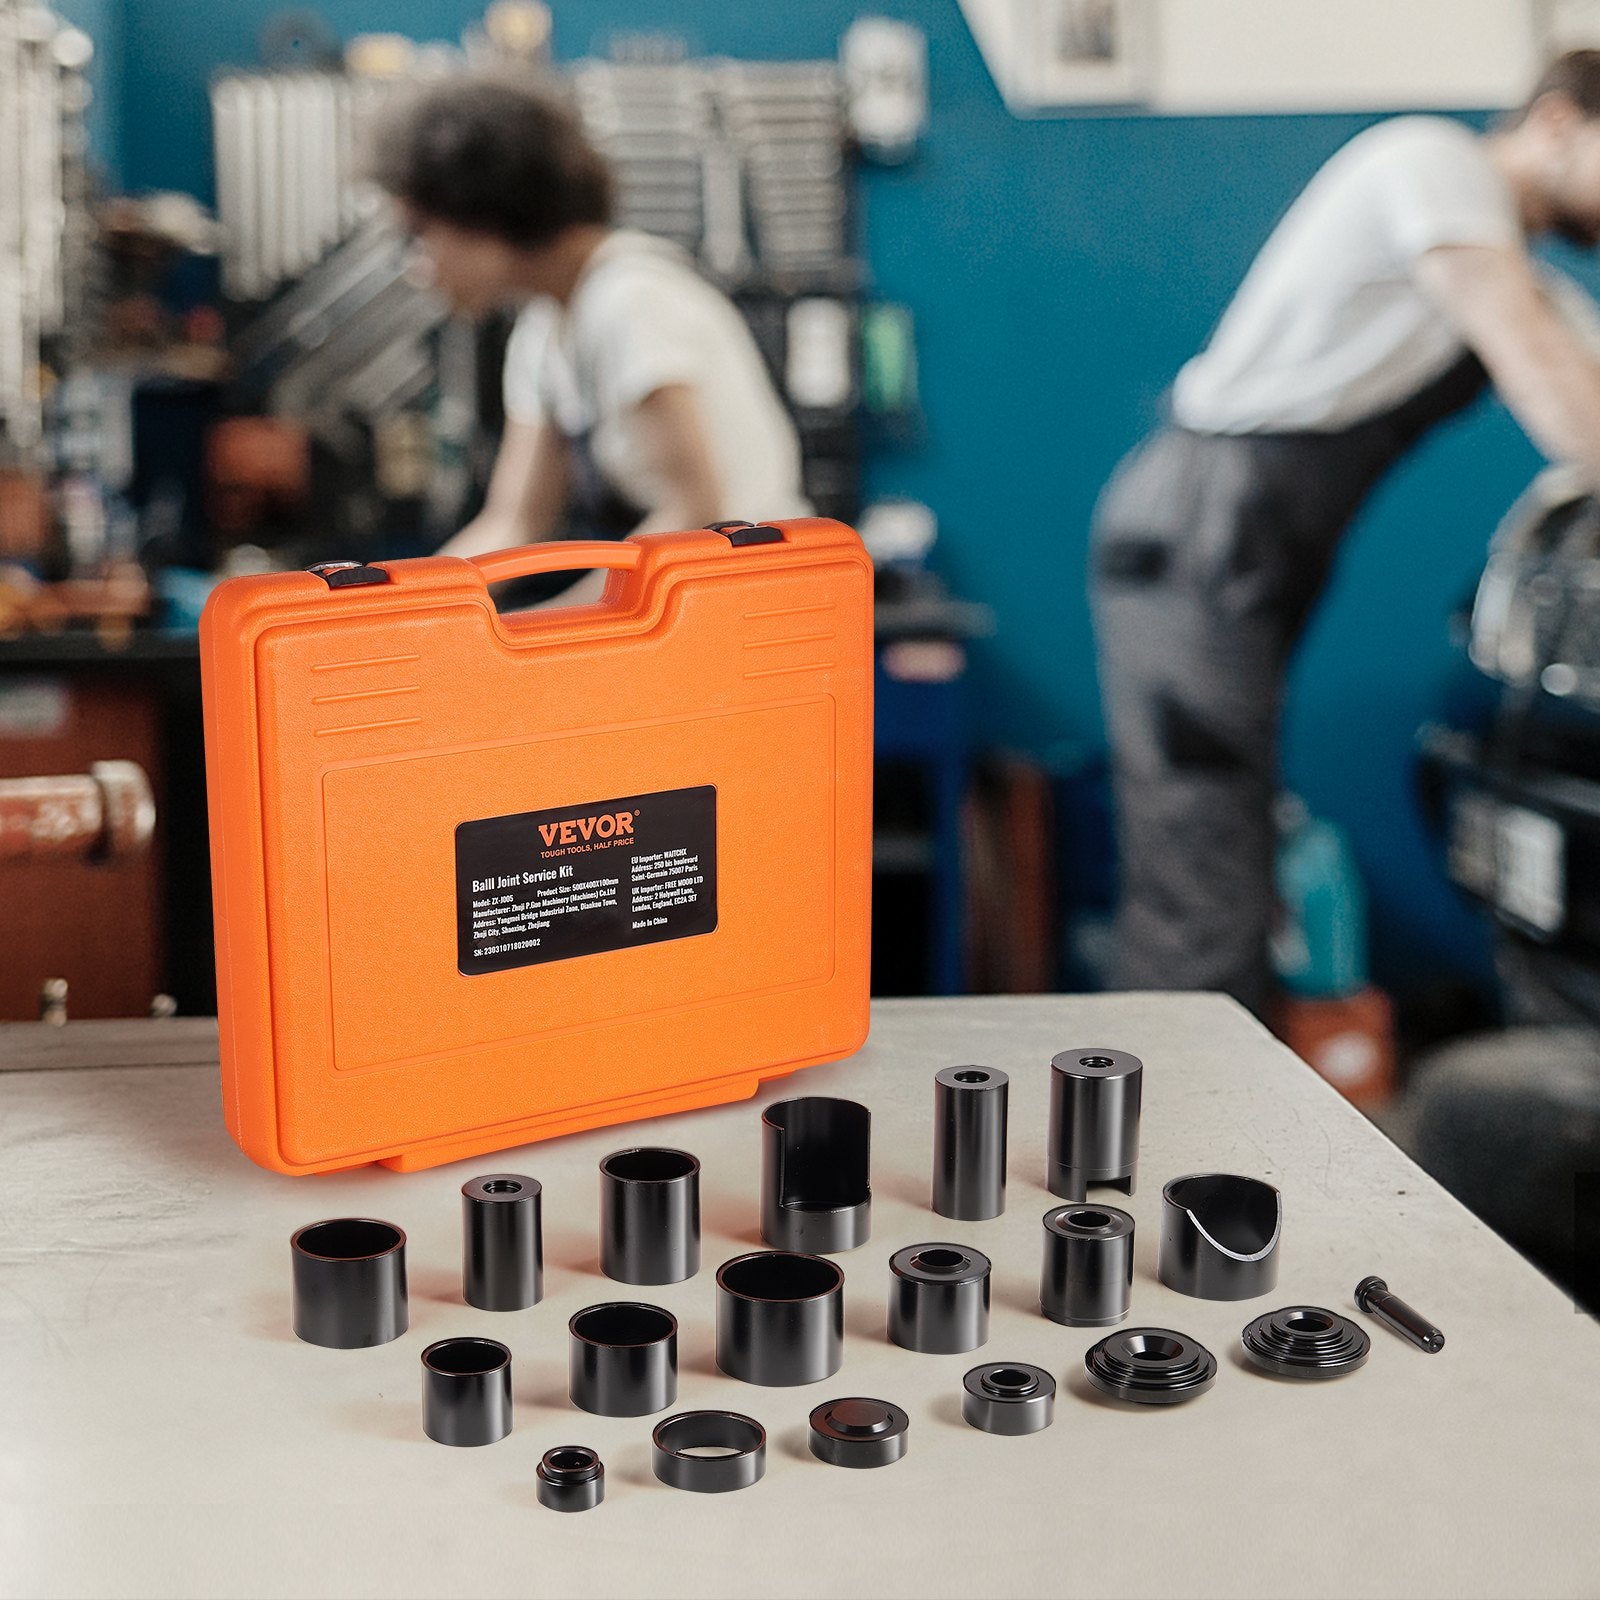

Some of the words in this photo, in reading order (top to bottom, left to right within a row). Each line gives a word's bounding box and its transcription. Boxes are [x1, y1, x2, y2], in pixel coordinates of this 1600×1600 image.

[538, 812, 634, 847] VEVOR
[541, 848, 565, 858] TOUGH
[567, 844, 592, 854] TOOLS,
[594, 841, 612, 849] HALF
[614, 838, 634, 847] PRICE
[639, 854, 663, 863] Importer:
[674, 855, 698, 865] boulevard
[497, 874, 520, 889] Joint
[523, 869, 557, 884] Service
[560, 866, 573, 878] Kit
[632, 870, 668, 881] Saint-Germain
[669, 866, 684, 875] 75007
[641, 884, 664, 893] Importer:
[665, 881, 677, 889] FREE
[678, 878, 693, 886] MOOD
[473, 899, 491, 908] Model:
[537, 888, 558, 897] Product
[473, 907, 511, 918] Manufacturer:
[542, 897, 569, 906] Machinery
[570, 891, 598, 903] (Machines)
[632, 895, 653, 903] Address:
[674, 896, 687, 905] EC2A
[473, 920, 496, 929] Address:
[521, 912, 538, 920] Bridge
[540, 907, 564, 917] Industrial
[528, 921, 550, 930] Zhejiang
[632, 921, 646, 929] Made
[653, 917, 667, 925] China
